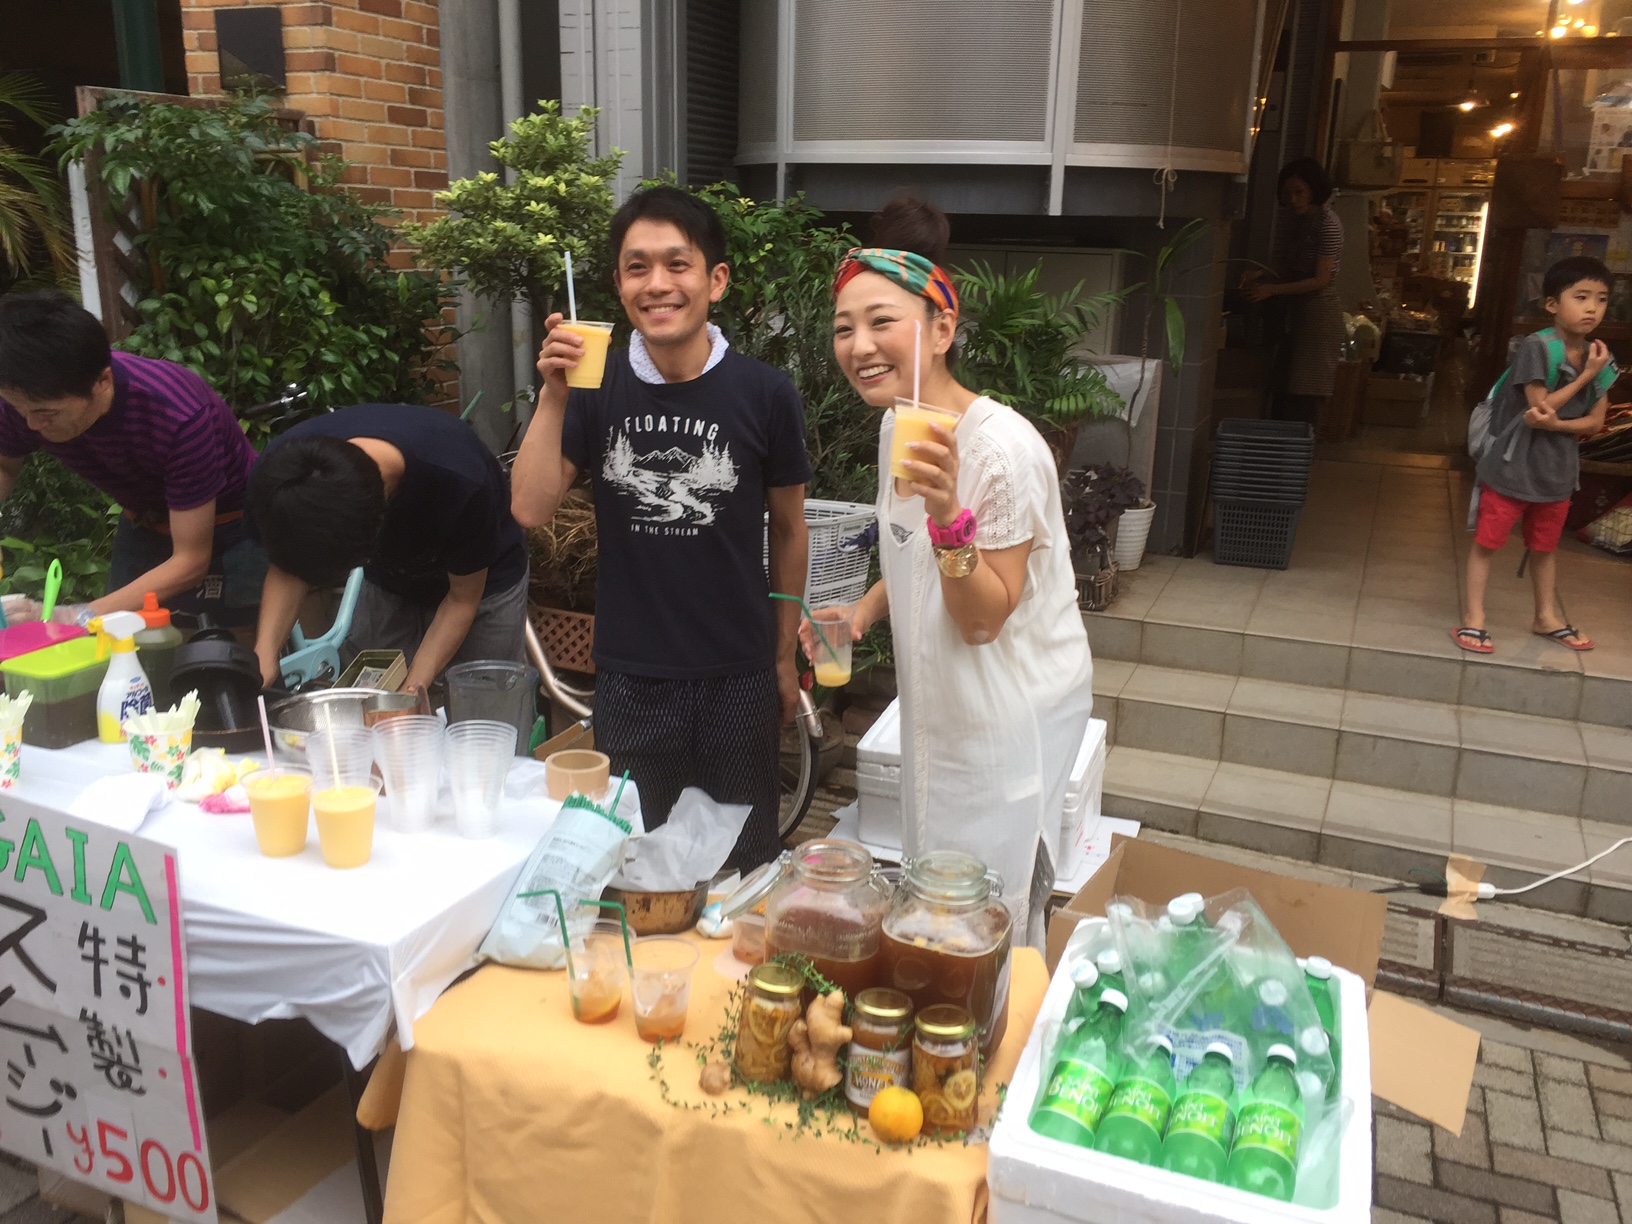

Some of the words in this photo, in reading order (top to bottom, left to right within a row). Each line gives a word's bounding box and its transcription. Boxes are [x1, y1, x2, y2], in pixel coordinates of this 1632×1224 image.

[624, 414, 719, 441] FLOATING
[630, 523, 641, 533] IN
[644, 524, 660, 535] THE
[664, 526, 700, 536] STREAM
[196, 574, 224, 599] 酒
